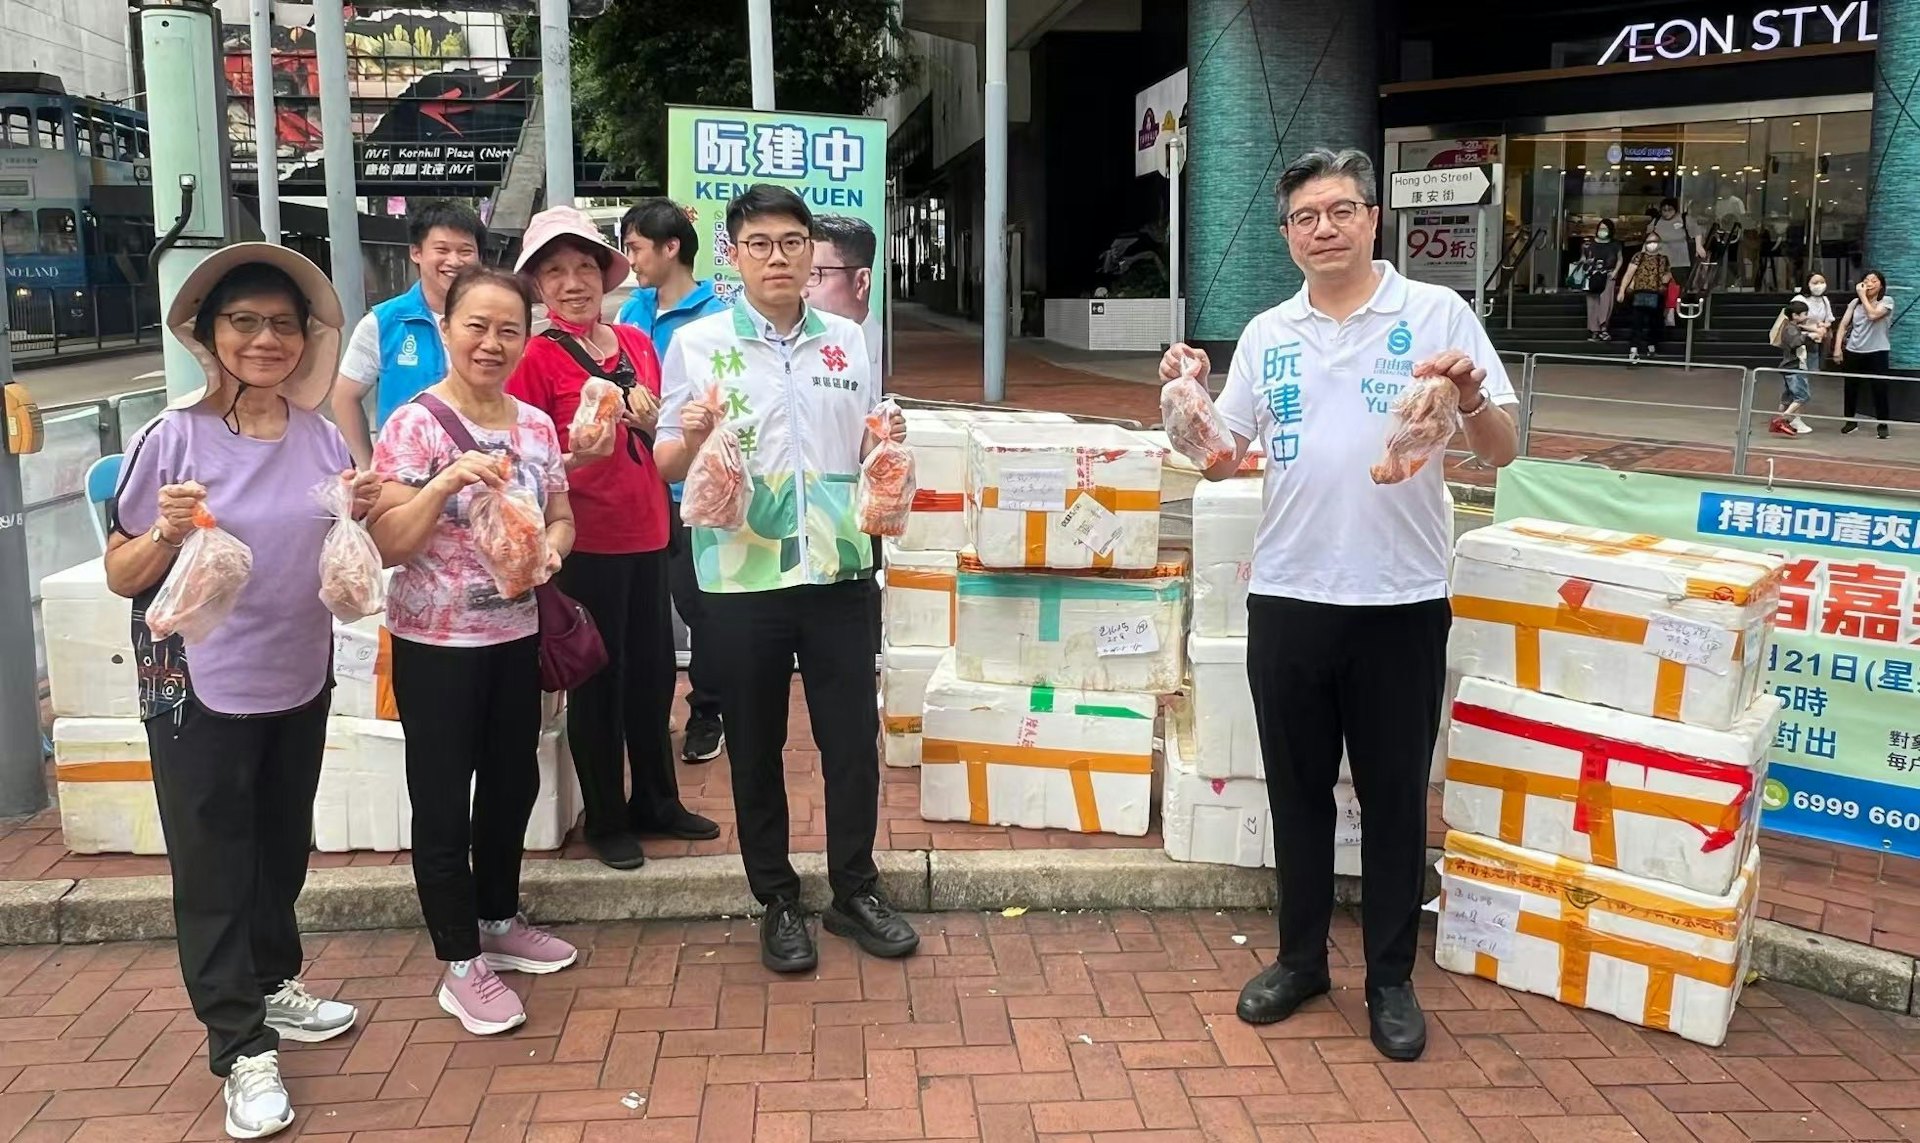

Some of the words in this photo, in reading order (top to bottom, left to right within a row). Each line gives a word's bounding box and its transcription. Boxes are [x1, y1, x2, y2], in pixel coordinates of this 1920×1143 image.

[1751, 1, 1879, 51] STYL
[399, 147, 440, 158] Kornhill
[447, 147, 474, 158] Plaza
[695, 119, 864, 182] 阮建中
[1395, 175, 1420, 186] Hong
[1423, 174, 1438, 184] On
[1440, 171, 1472, 183] Street
[696, 181, 750, 201] KEN
[794, 186, 863, 207] YUEN
[1411, 189, 1455, 203] 康安街
[25, 266, 59, 277] LAND
[1361, 378, 1405, 395] Ken
[1263, 342, 1303, 470] 阮建中
[1365, 397, 1388, 413] Yu
[1768, 644, 1920, 694] 21日(星
[1794, 790, 1860, 820] 6999
